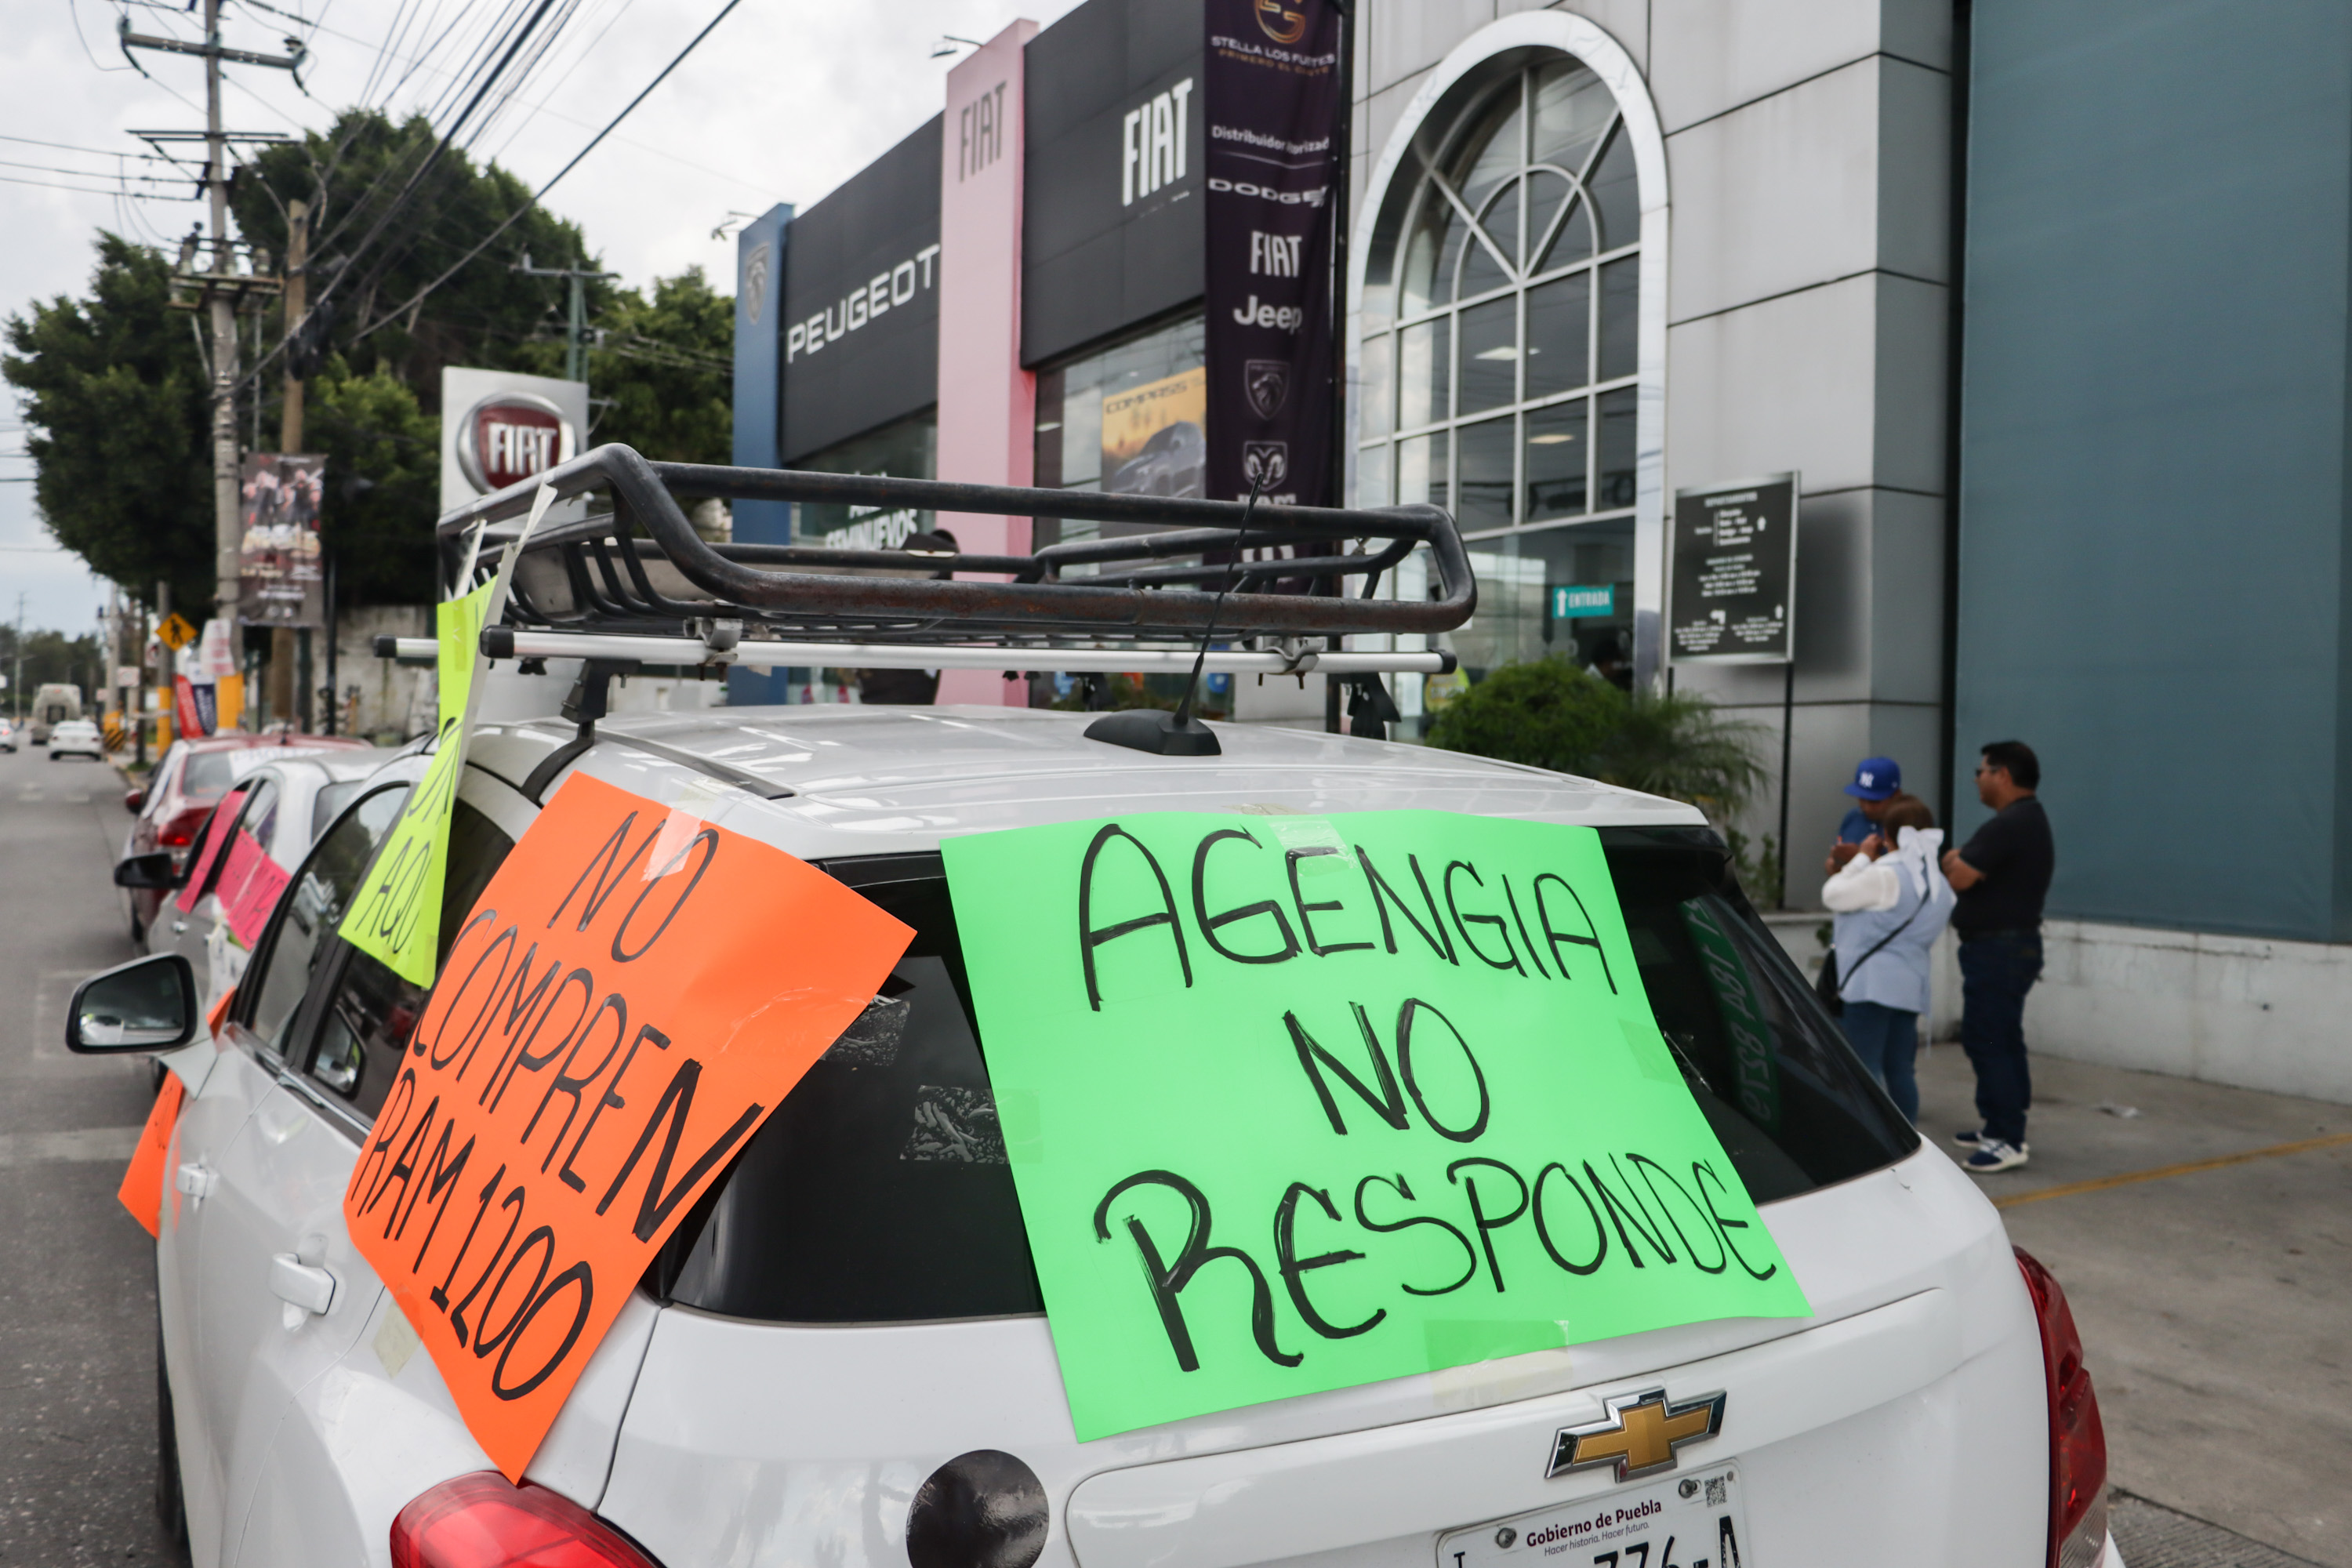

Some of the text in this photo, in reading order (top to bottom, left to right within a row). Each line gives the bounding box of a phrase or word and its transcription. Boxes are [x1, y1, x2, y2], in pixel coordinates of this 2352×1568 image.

[1211, 36, 1262, 55] STELLA
[1265, 47, 1290, 63] LOS
[960, 79, 1007, 183] FIAT
[1123, 78, 1193, 207] FIAT
[1208, 178, 1325, 205] DODGE
[1250, 230, 1302, 278] FIAT
[788, 244, 940, 364] PEUGEOT
[1233, 295, 1302, 335] Jeep
[488, 422, 557, 475] FIAT
[1570, 591, 1610, 609] ENTRADA
[547, 809, 719, 963] NO
[412, 908, 766, 1243] COMPREN
[1283, 997, 1491, 1143] NO
[350, 1068, 594, 1401] RAM 1200
[1094, 1152, 1777, 1374] RESPONDE
[1526, 1499, 1662, 1547] Gobierno de Puebla
[1544, 1541, 1569, 1556] Hacer
[1602, 1528, 1625, 1542] Hacer
